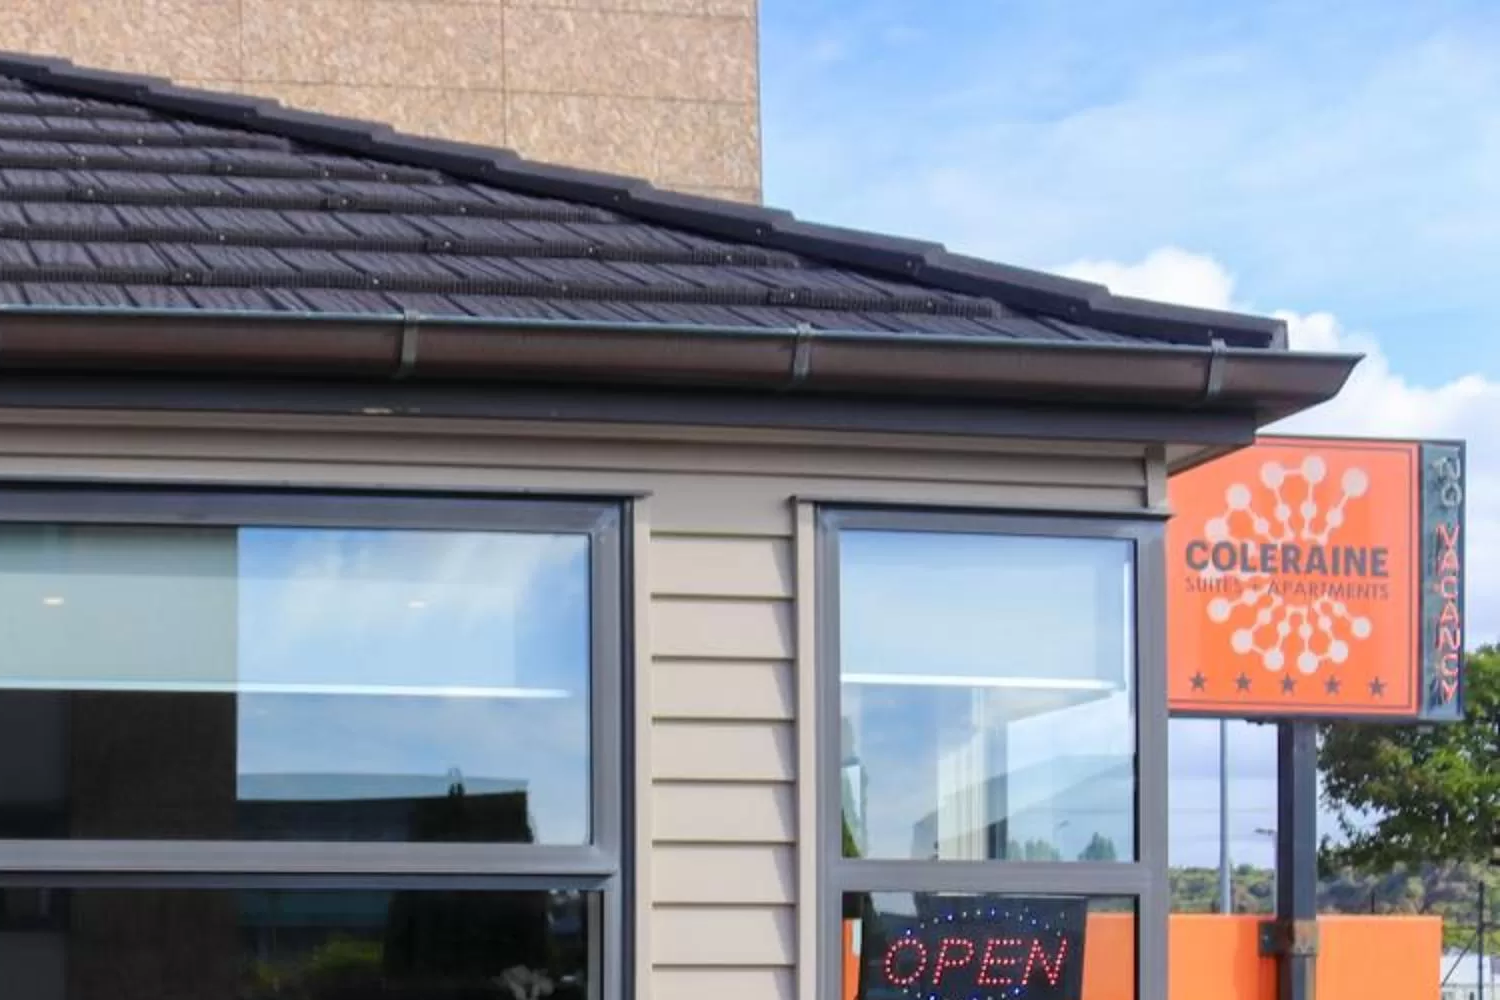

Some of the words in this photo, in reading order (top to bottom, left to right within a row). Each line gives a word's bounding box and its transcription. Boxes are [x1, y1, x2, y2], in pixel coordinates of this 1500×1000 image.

[1185, 540, 1389, 577] COLERAINE
[1185, 575, 1244, 595] SUITES
[1267, 577, 1389, 600] APARTMENTS
[1436, 524, 1460, 703] VACANCY
[884, 936, 1068, 985] OPEN
